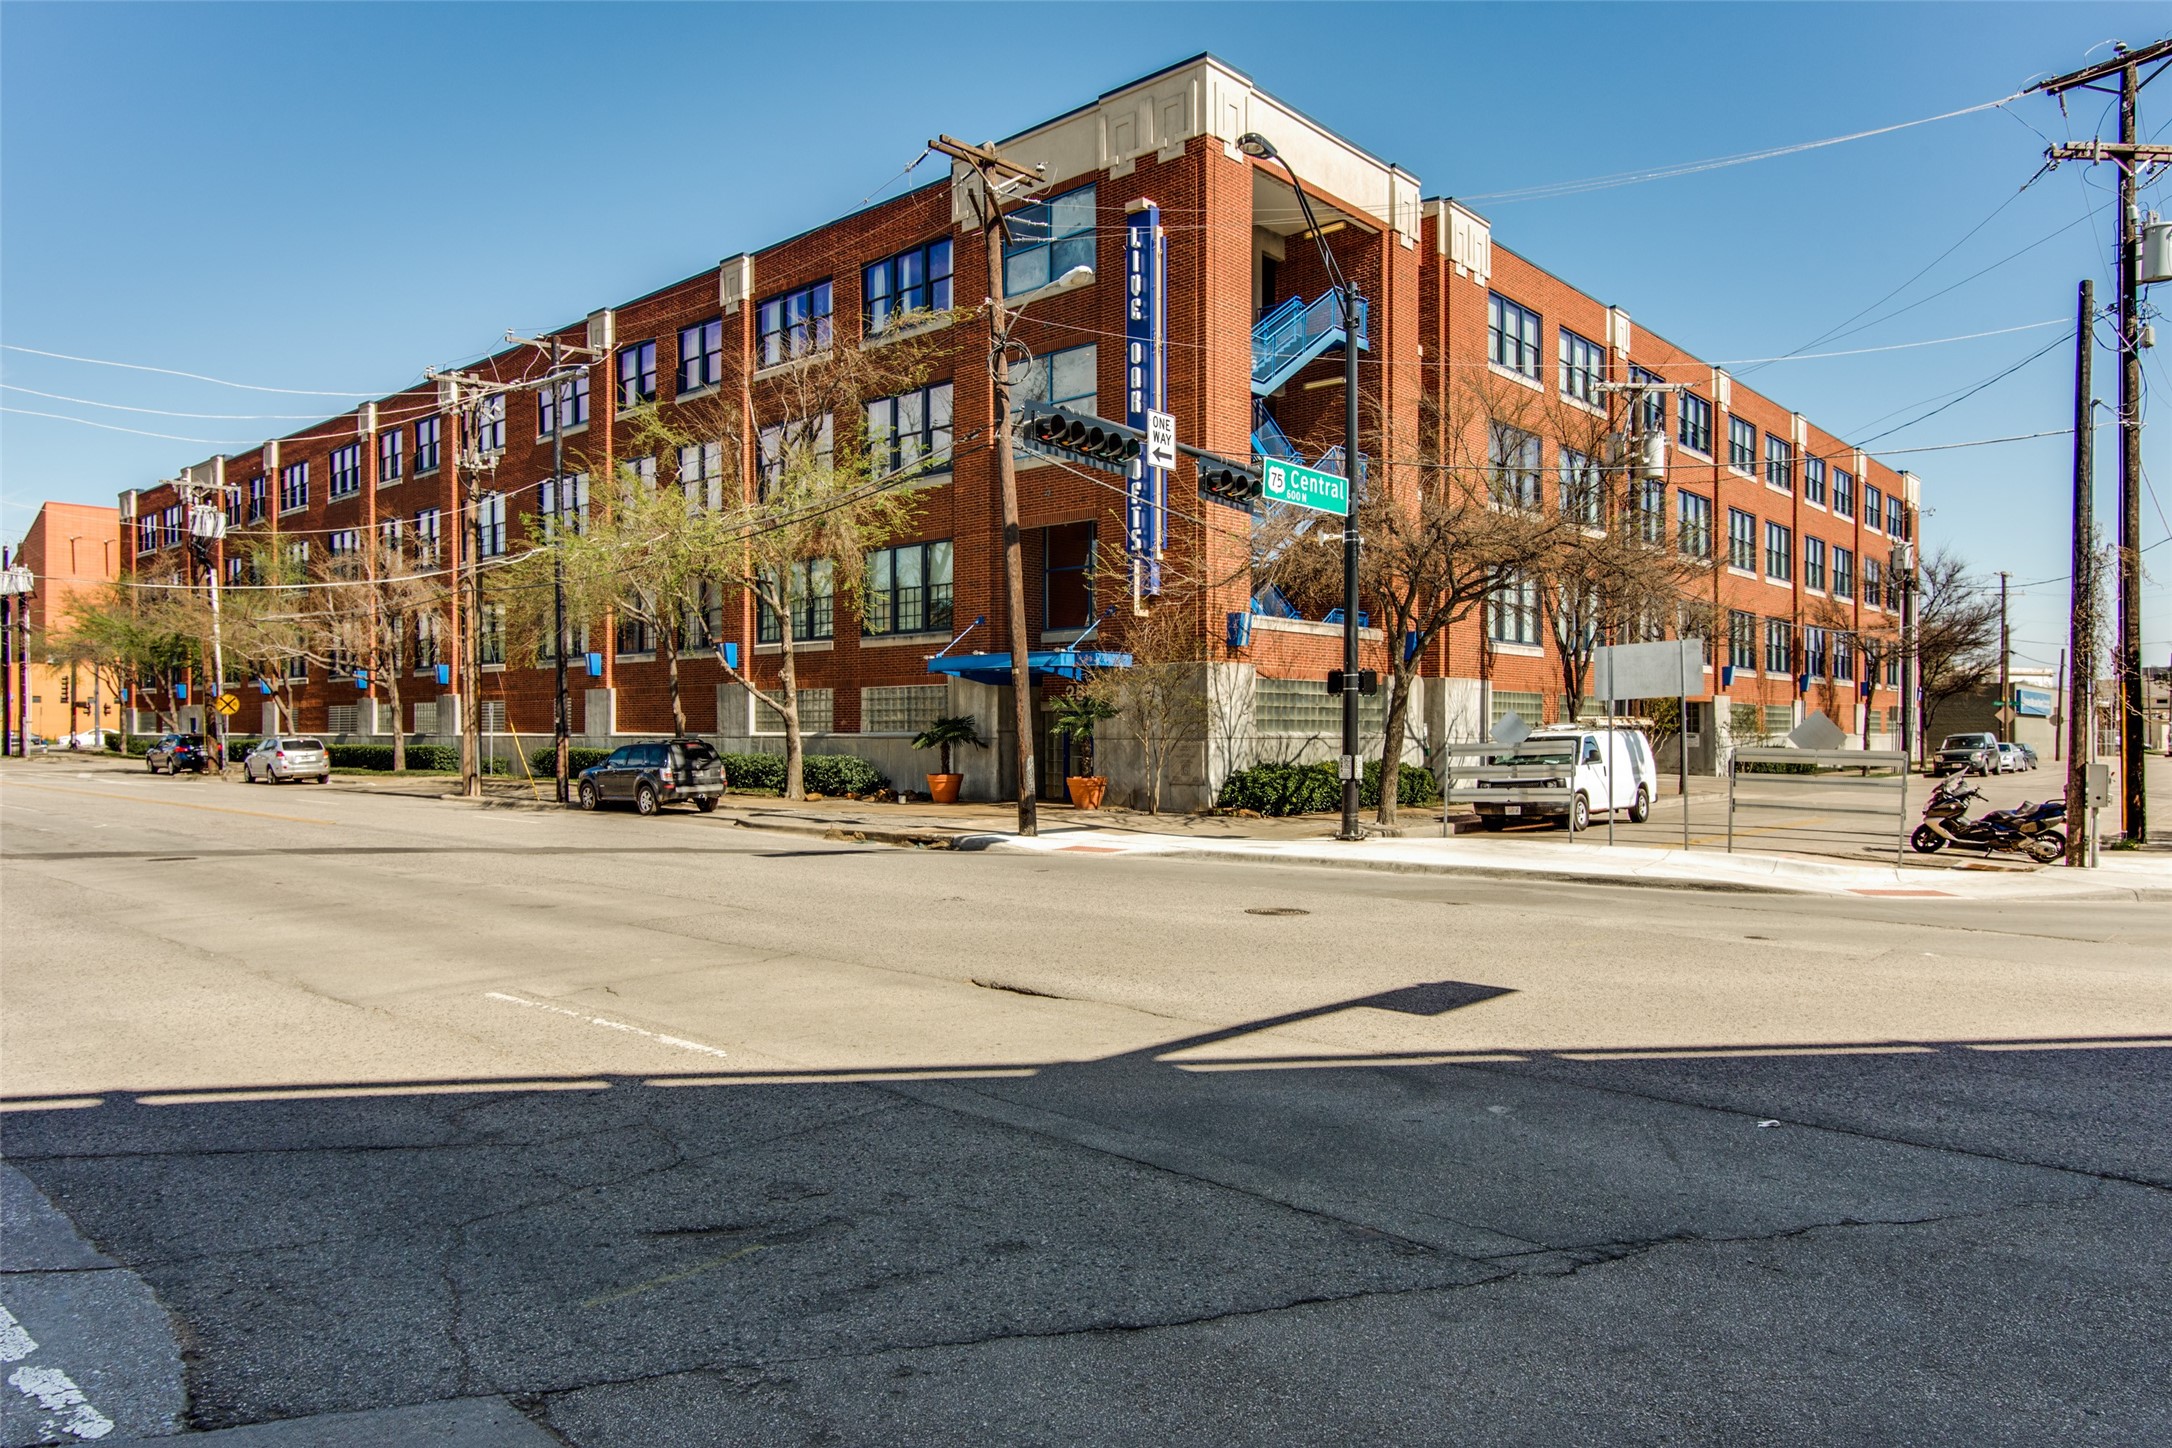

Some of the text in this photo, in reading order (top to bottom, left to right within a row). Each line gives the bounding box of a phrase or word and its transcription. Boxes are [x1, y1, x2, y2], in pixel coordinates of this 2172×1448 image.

[1131, 227, 1142, 550] LIVE OAK OFTS
[1153, 416, 1171, 431] ONE
[1153, 430, 1171, 446] WAY
[1271, 470, 1344, 500] 75 Central
[1286, 489, 1301, 501] 600
